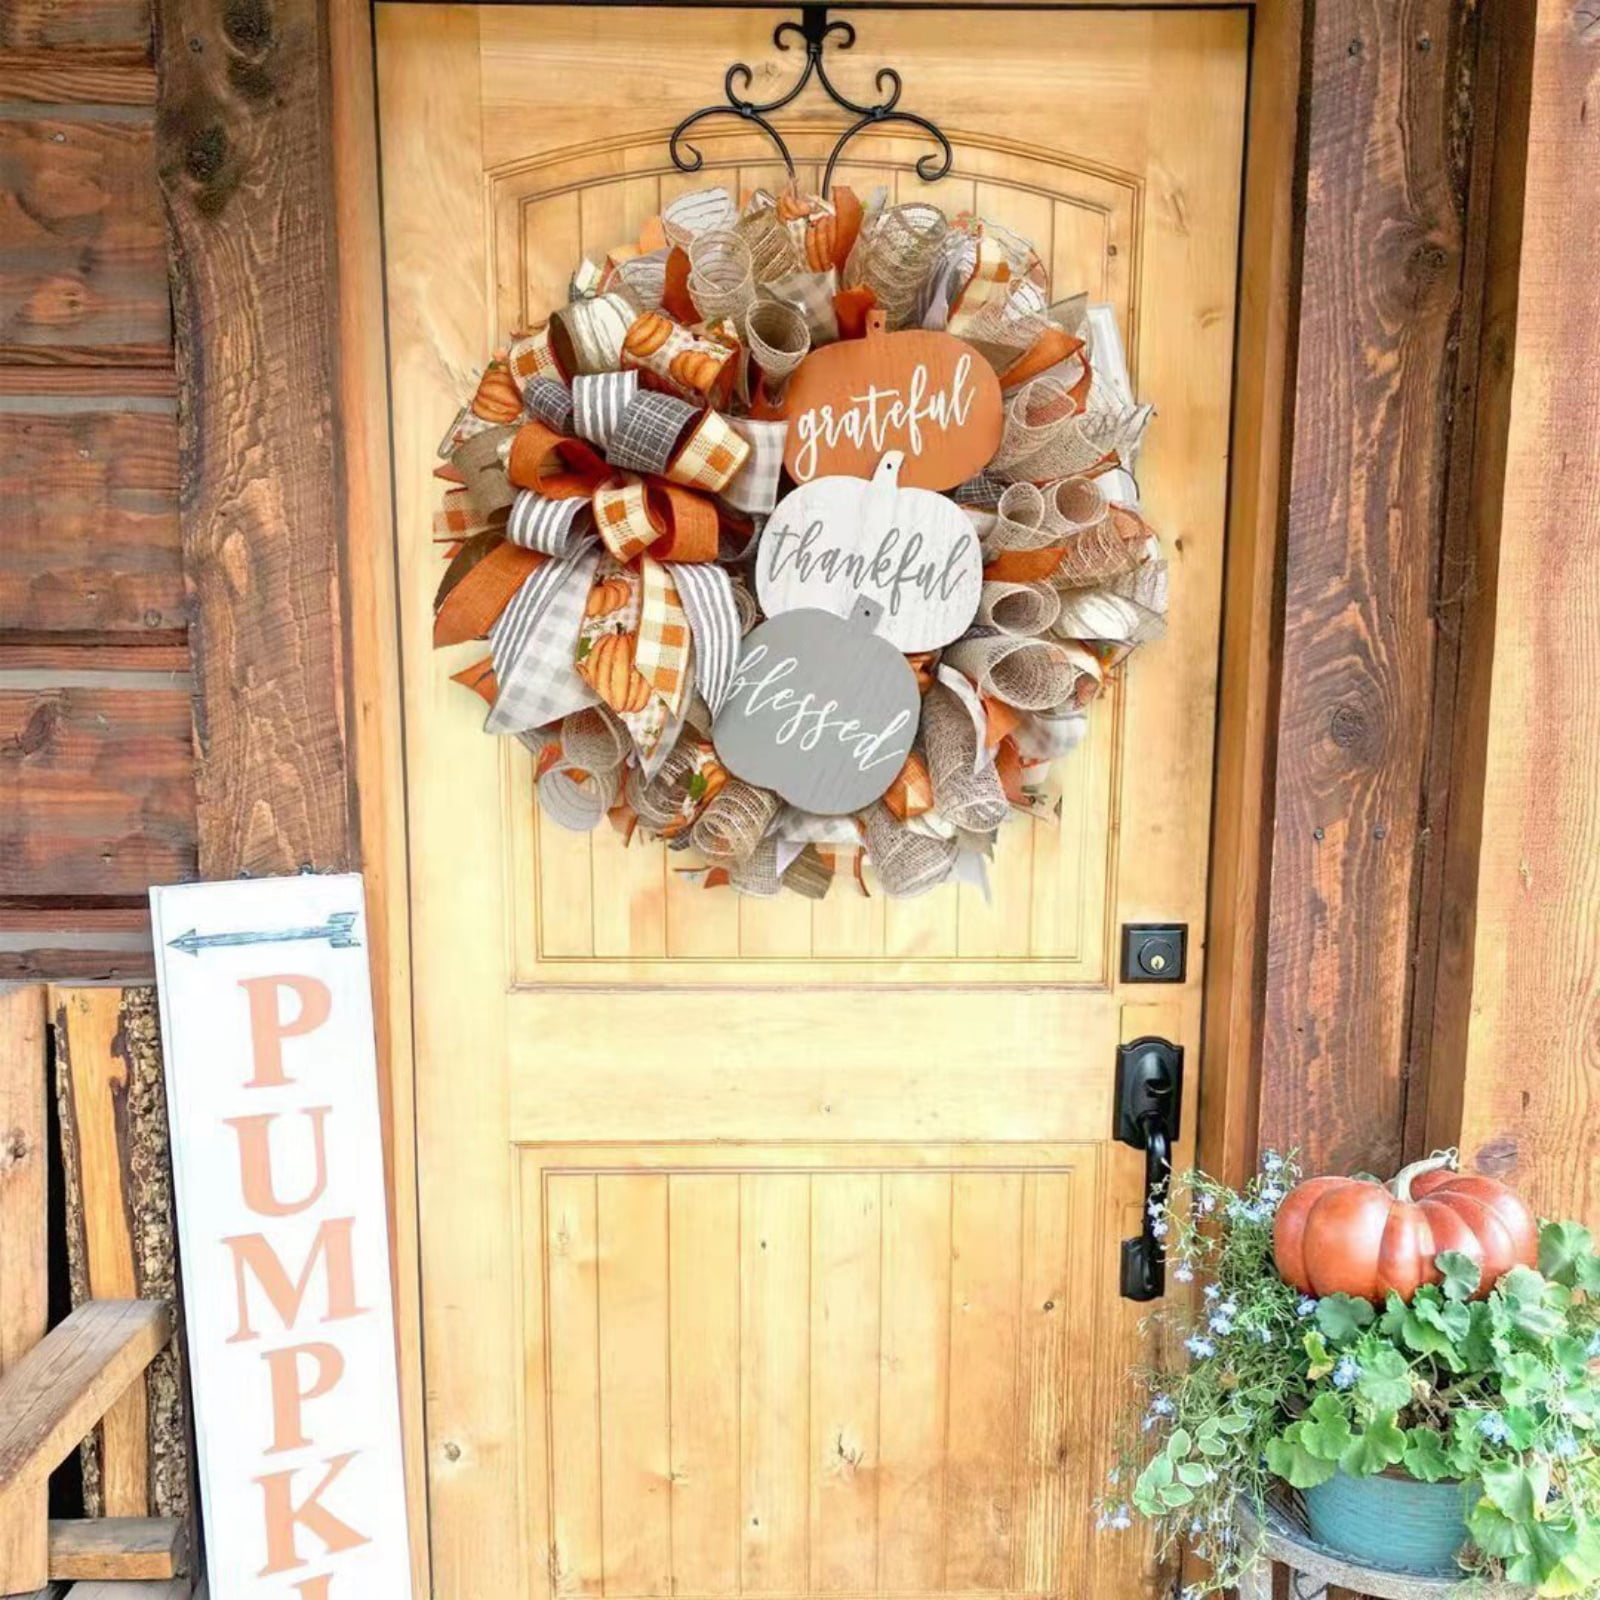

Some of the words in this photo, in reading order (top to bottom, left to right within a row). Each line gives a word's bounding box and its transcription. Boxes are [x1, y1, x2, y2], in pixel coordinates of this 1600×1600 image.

[795, 353, 976, 482] grateful
[769, 520, 972, 616] thankful
[727, 644, 911, 772] blessed
[219, 973, 374, 1600] PUMPK
